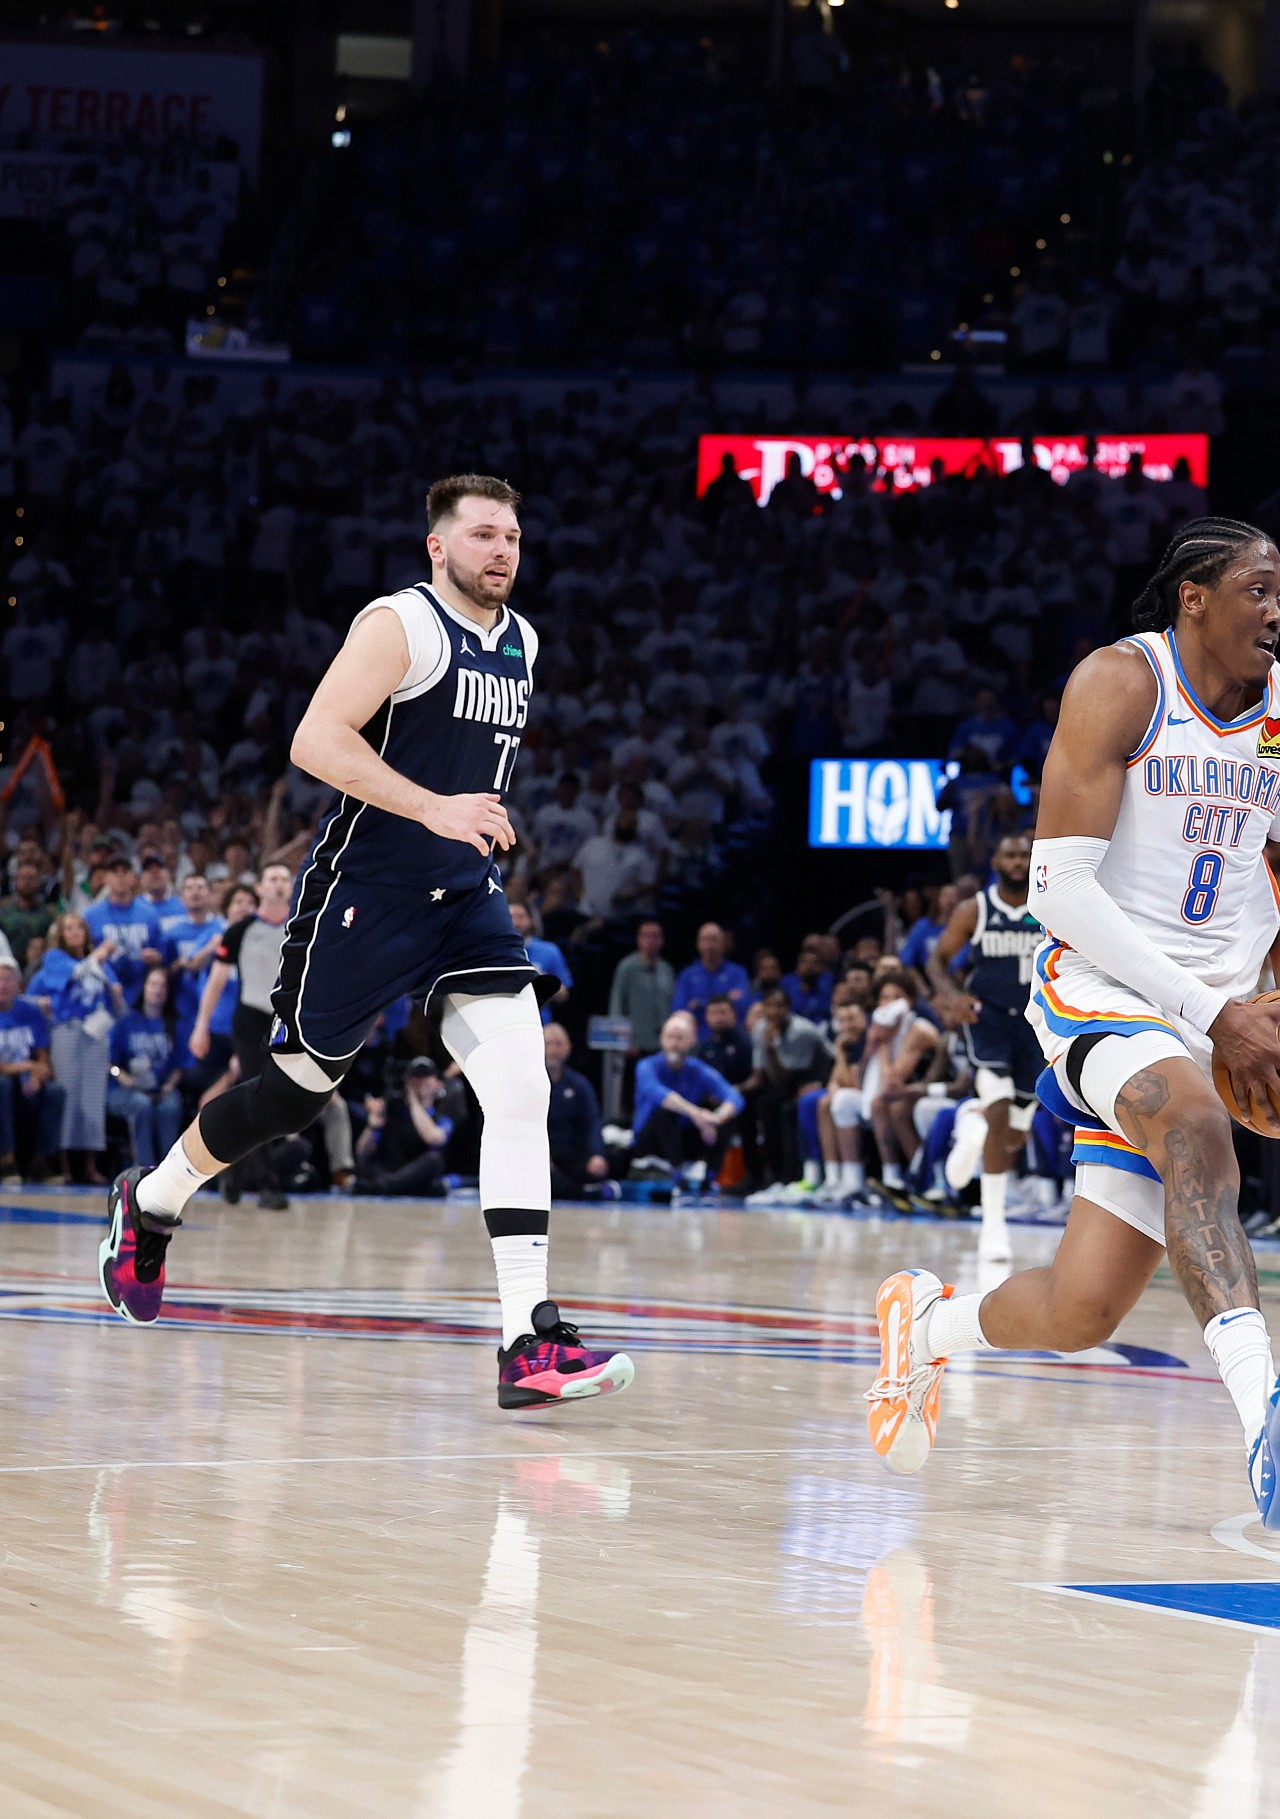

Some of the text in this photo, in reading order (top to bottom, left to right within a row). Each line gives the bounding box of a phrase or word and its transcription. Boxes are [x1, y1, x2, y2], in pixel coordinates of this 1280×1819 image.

[26, 84, 212, 137] TERRACE
[453, 668, 529, 729] MAVS
[493, 732, 521, 793] 77
[1182, 802, 1251, 847] CITY
[1180, 850, 1226, 925] 8
